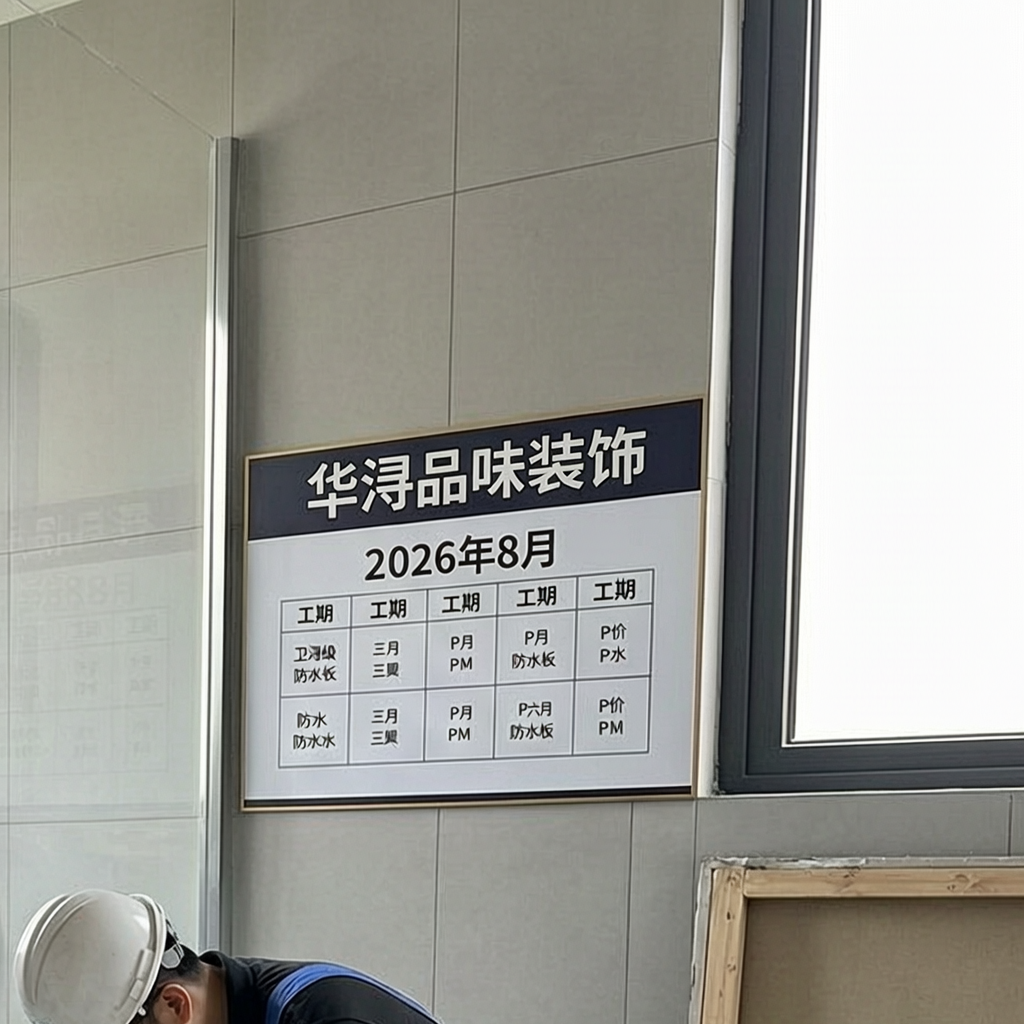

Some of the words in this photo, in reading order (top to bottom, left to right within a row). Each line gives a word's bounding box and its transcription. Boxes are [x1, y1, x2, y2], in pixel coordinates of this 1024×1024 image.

[307, 427, 647, 519] 华浔品味装饰
[365, 529, 556, 581] 2026年8月
[517, 586, 556, 606] 工期
[594, 579, 635, 601] 工期
[371, 599, 406, 618] 工期
[442, 593, 479, 613] 工期
[298, 605, 333, 623] 工期
[525, 630, 547, 645] P月
[601, 623, 626, 640] P价
[373, 641, 398, 655] 三月
[451, 635, 472, 650] P月
[601, 646, 626, 662] P水
[451, 657, 472, 671] PM
[451, 706, 471, 720] P月
[519, 702, 551, 717] P六月
[600, 697, 624, 713] P价
[298, 712, 327, 728] 防水
[372, 709, 397, 724] 三月
[449, 728, 470, 741] PM
[600, 721, 623, 735] PM
[294, 733, 335, 749] 防水水
